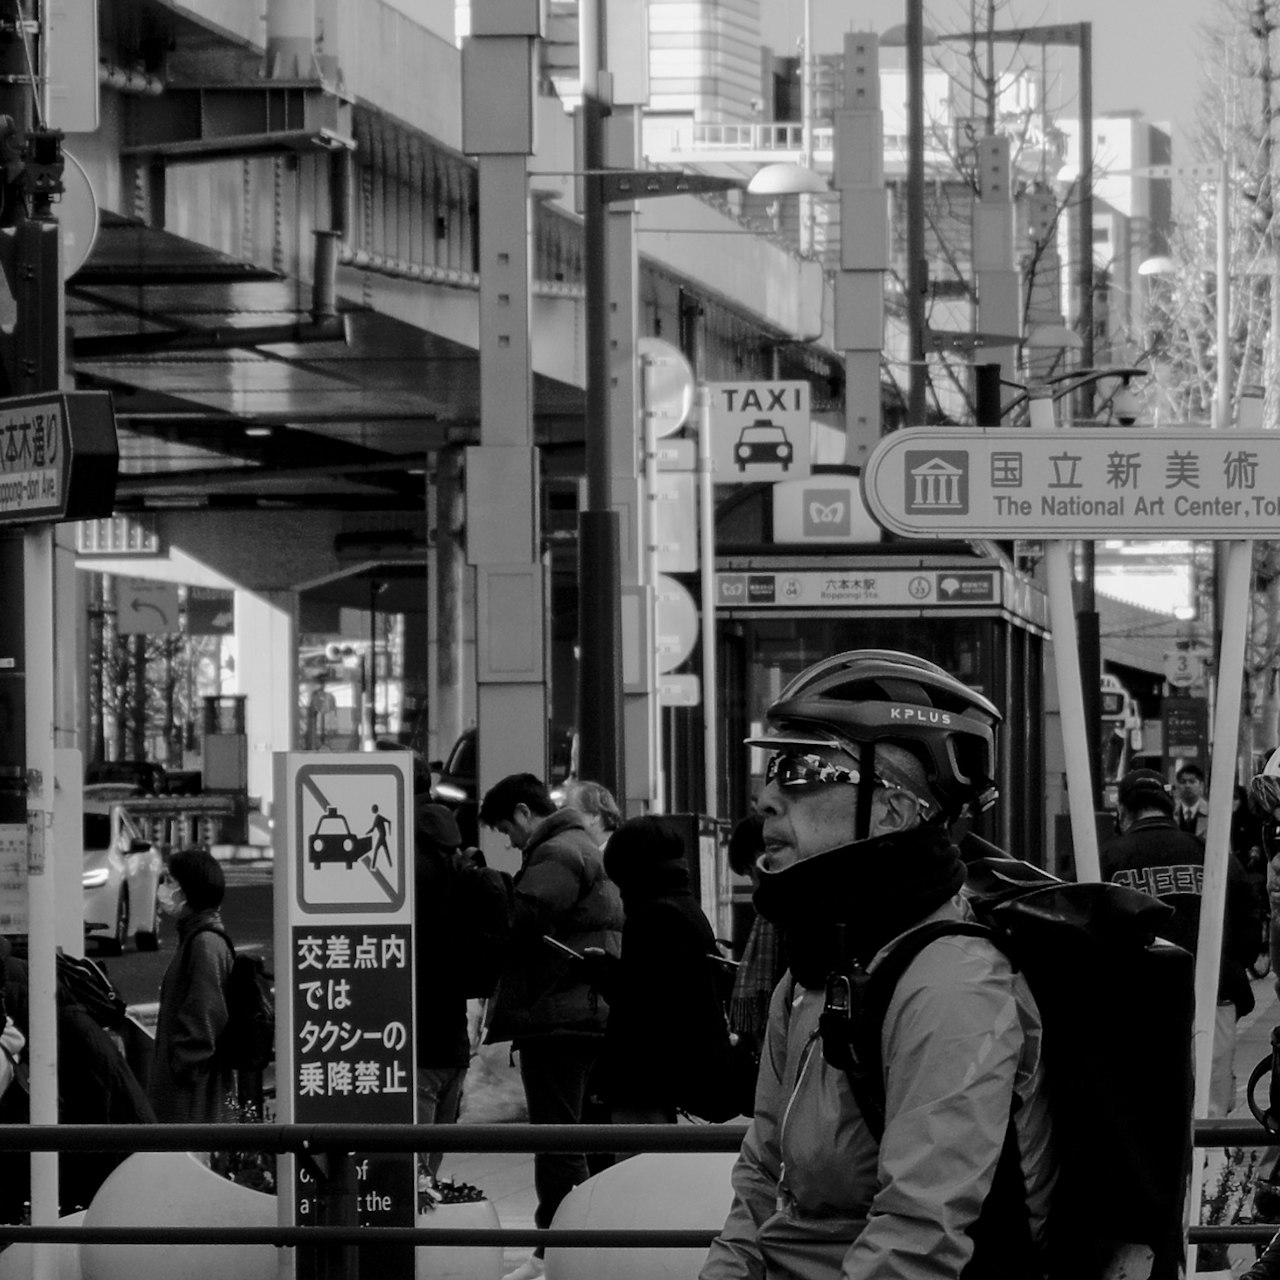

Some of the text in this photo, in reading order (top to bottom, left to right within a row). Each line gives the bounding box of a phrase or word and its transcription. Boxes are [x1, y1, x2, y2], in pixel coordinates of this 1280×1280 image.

[721, 388, 801, 412] TAXI
[993, 496, 1032, 516] The
[1041, 496, 1125, 516] National
[1134, 496, 1165, 516] Art
[825, 578, 876, 591] 六本木駅
[890, 707, 952, 725] KPLUS
[297, 934, 407, 971] 交差点内
[298, 978, 352, 1012] では
[298, 1020, 408, 1054] タクシーの
[298, 1060, 408, 1097] 乗降禁止
[365, 1190, 392, 1212] the
